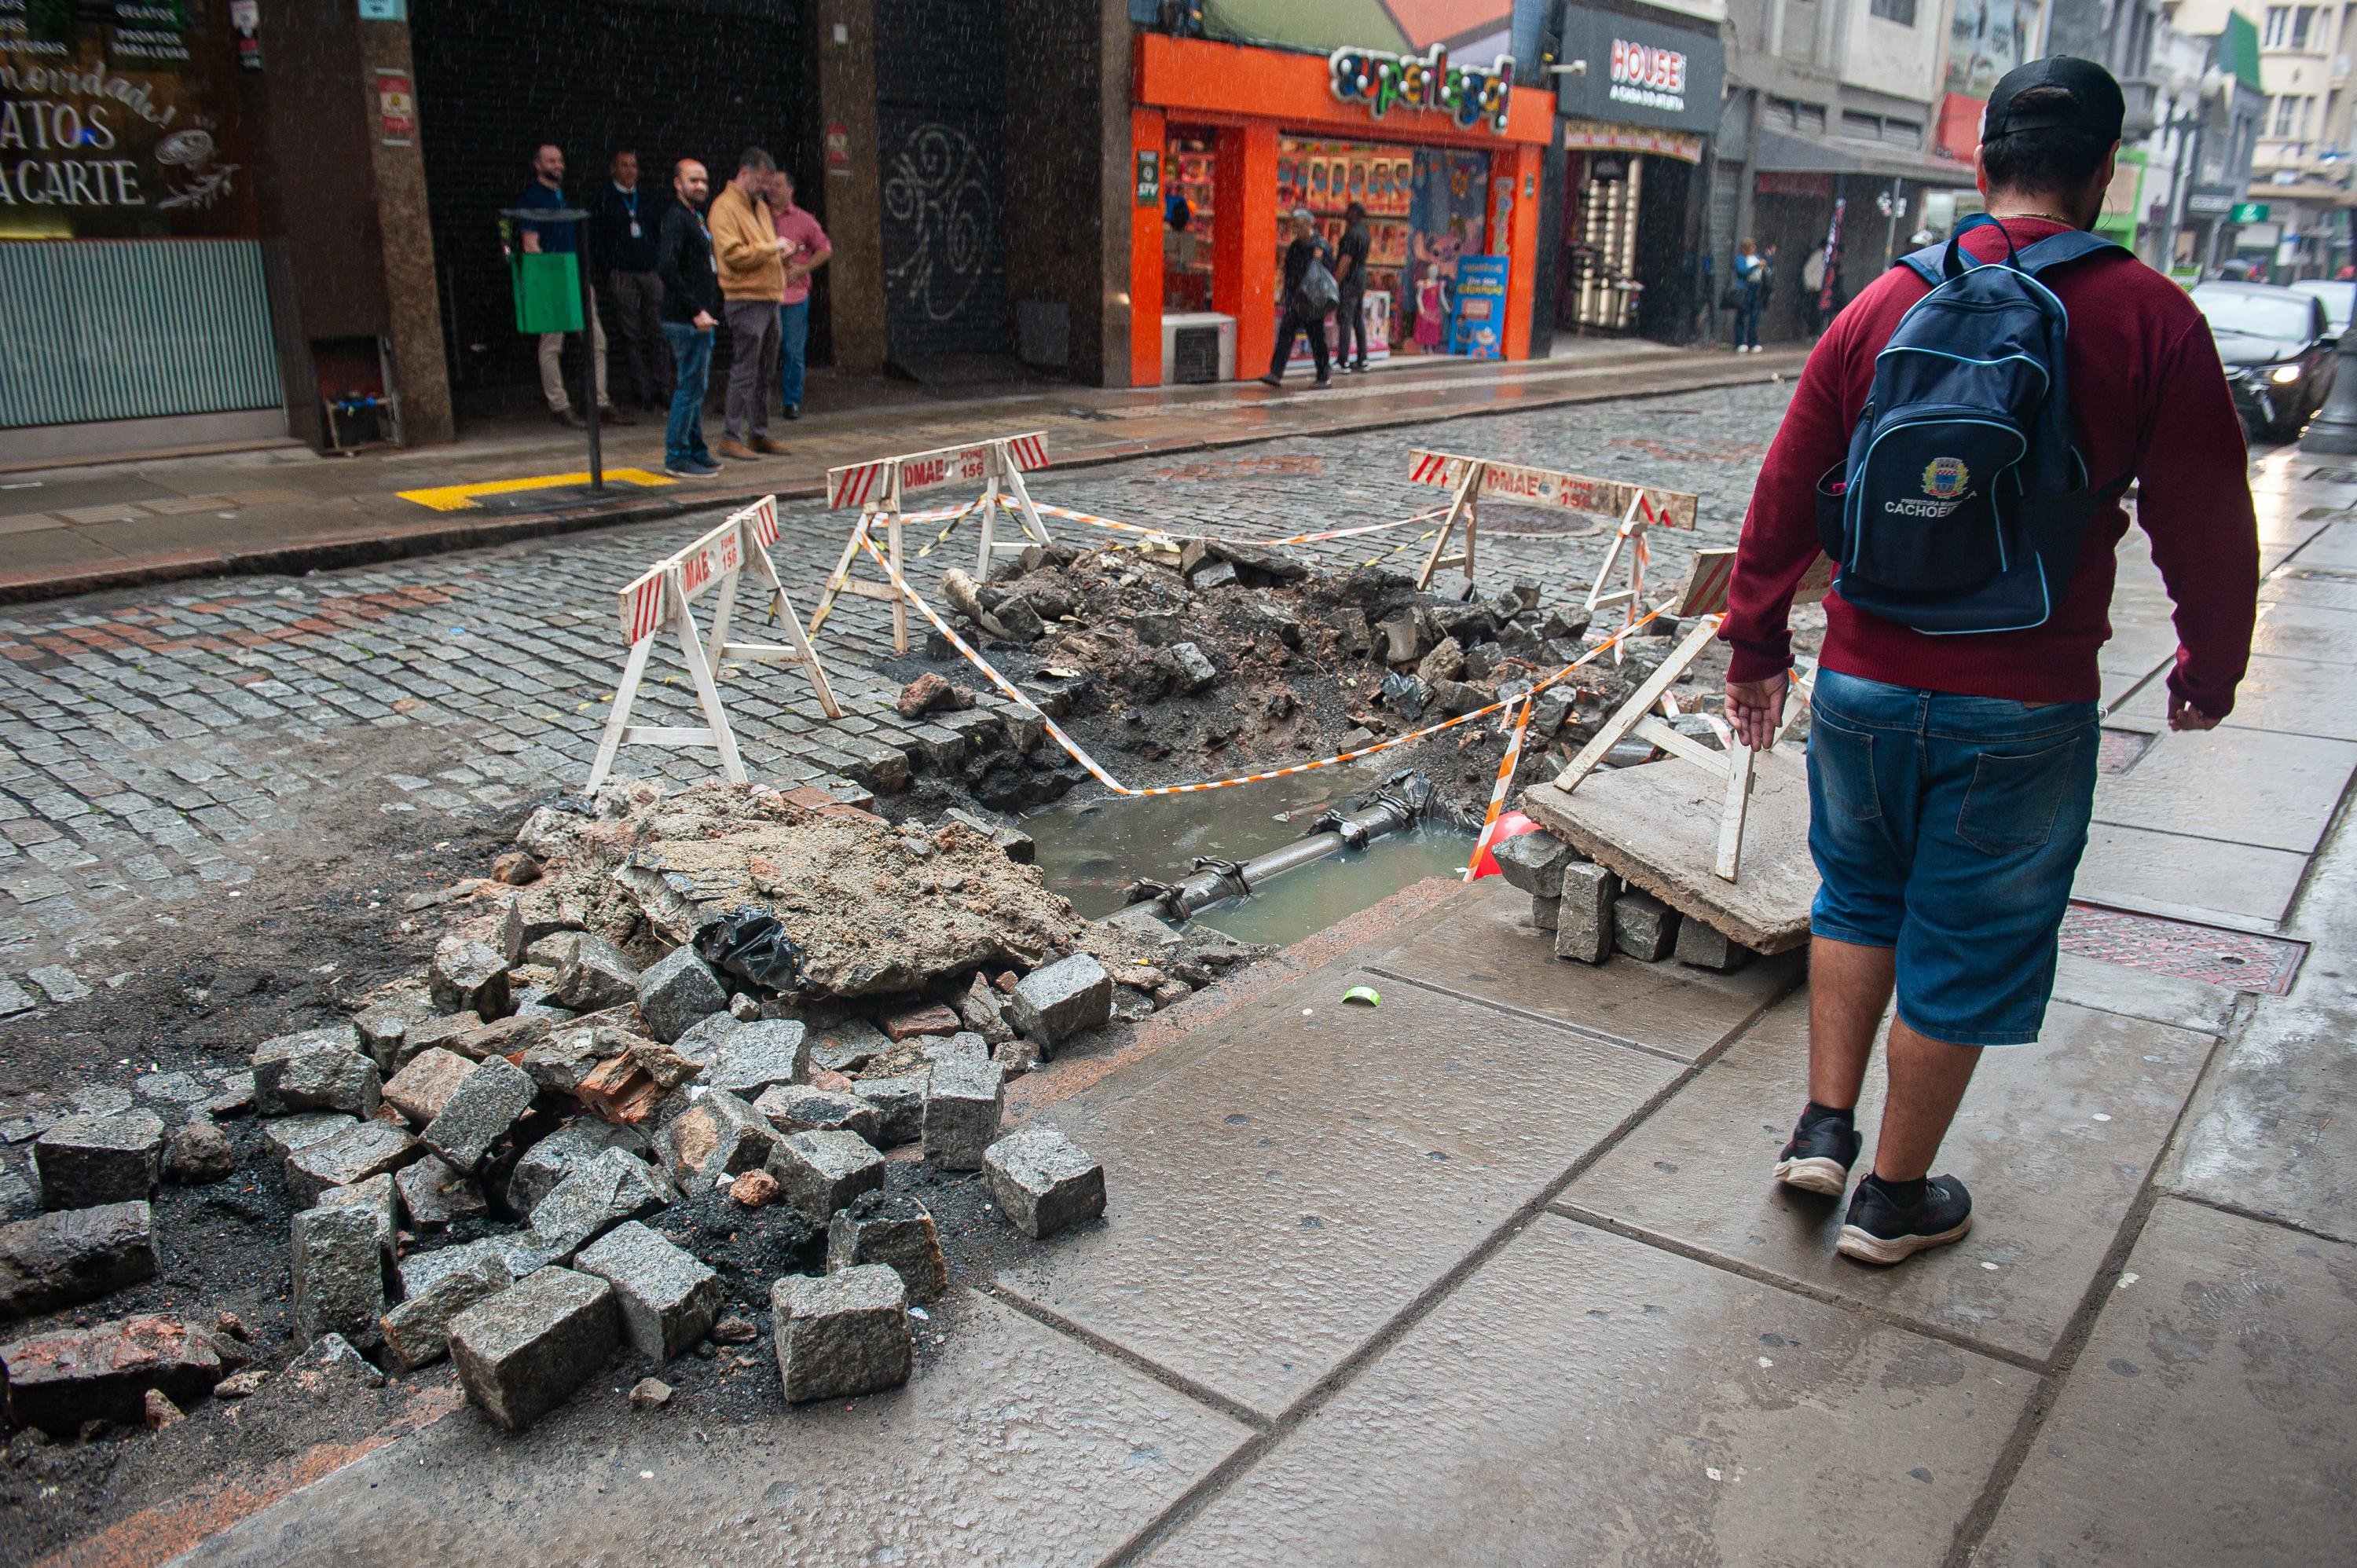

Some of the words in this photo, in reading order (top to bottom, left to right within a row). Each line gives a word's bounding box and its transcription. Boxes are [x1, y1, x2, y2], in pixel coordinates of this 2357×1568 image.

[1610, 38, 1682, 94] HOUSE
[16, 159, 146, 206] CARTE
[904, 459, 944, 488] DMAE
[685, 549, 709, 592] MAE
